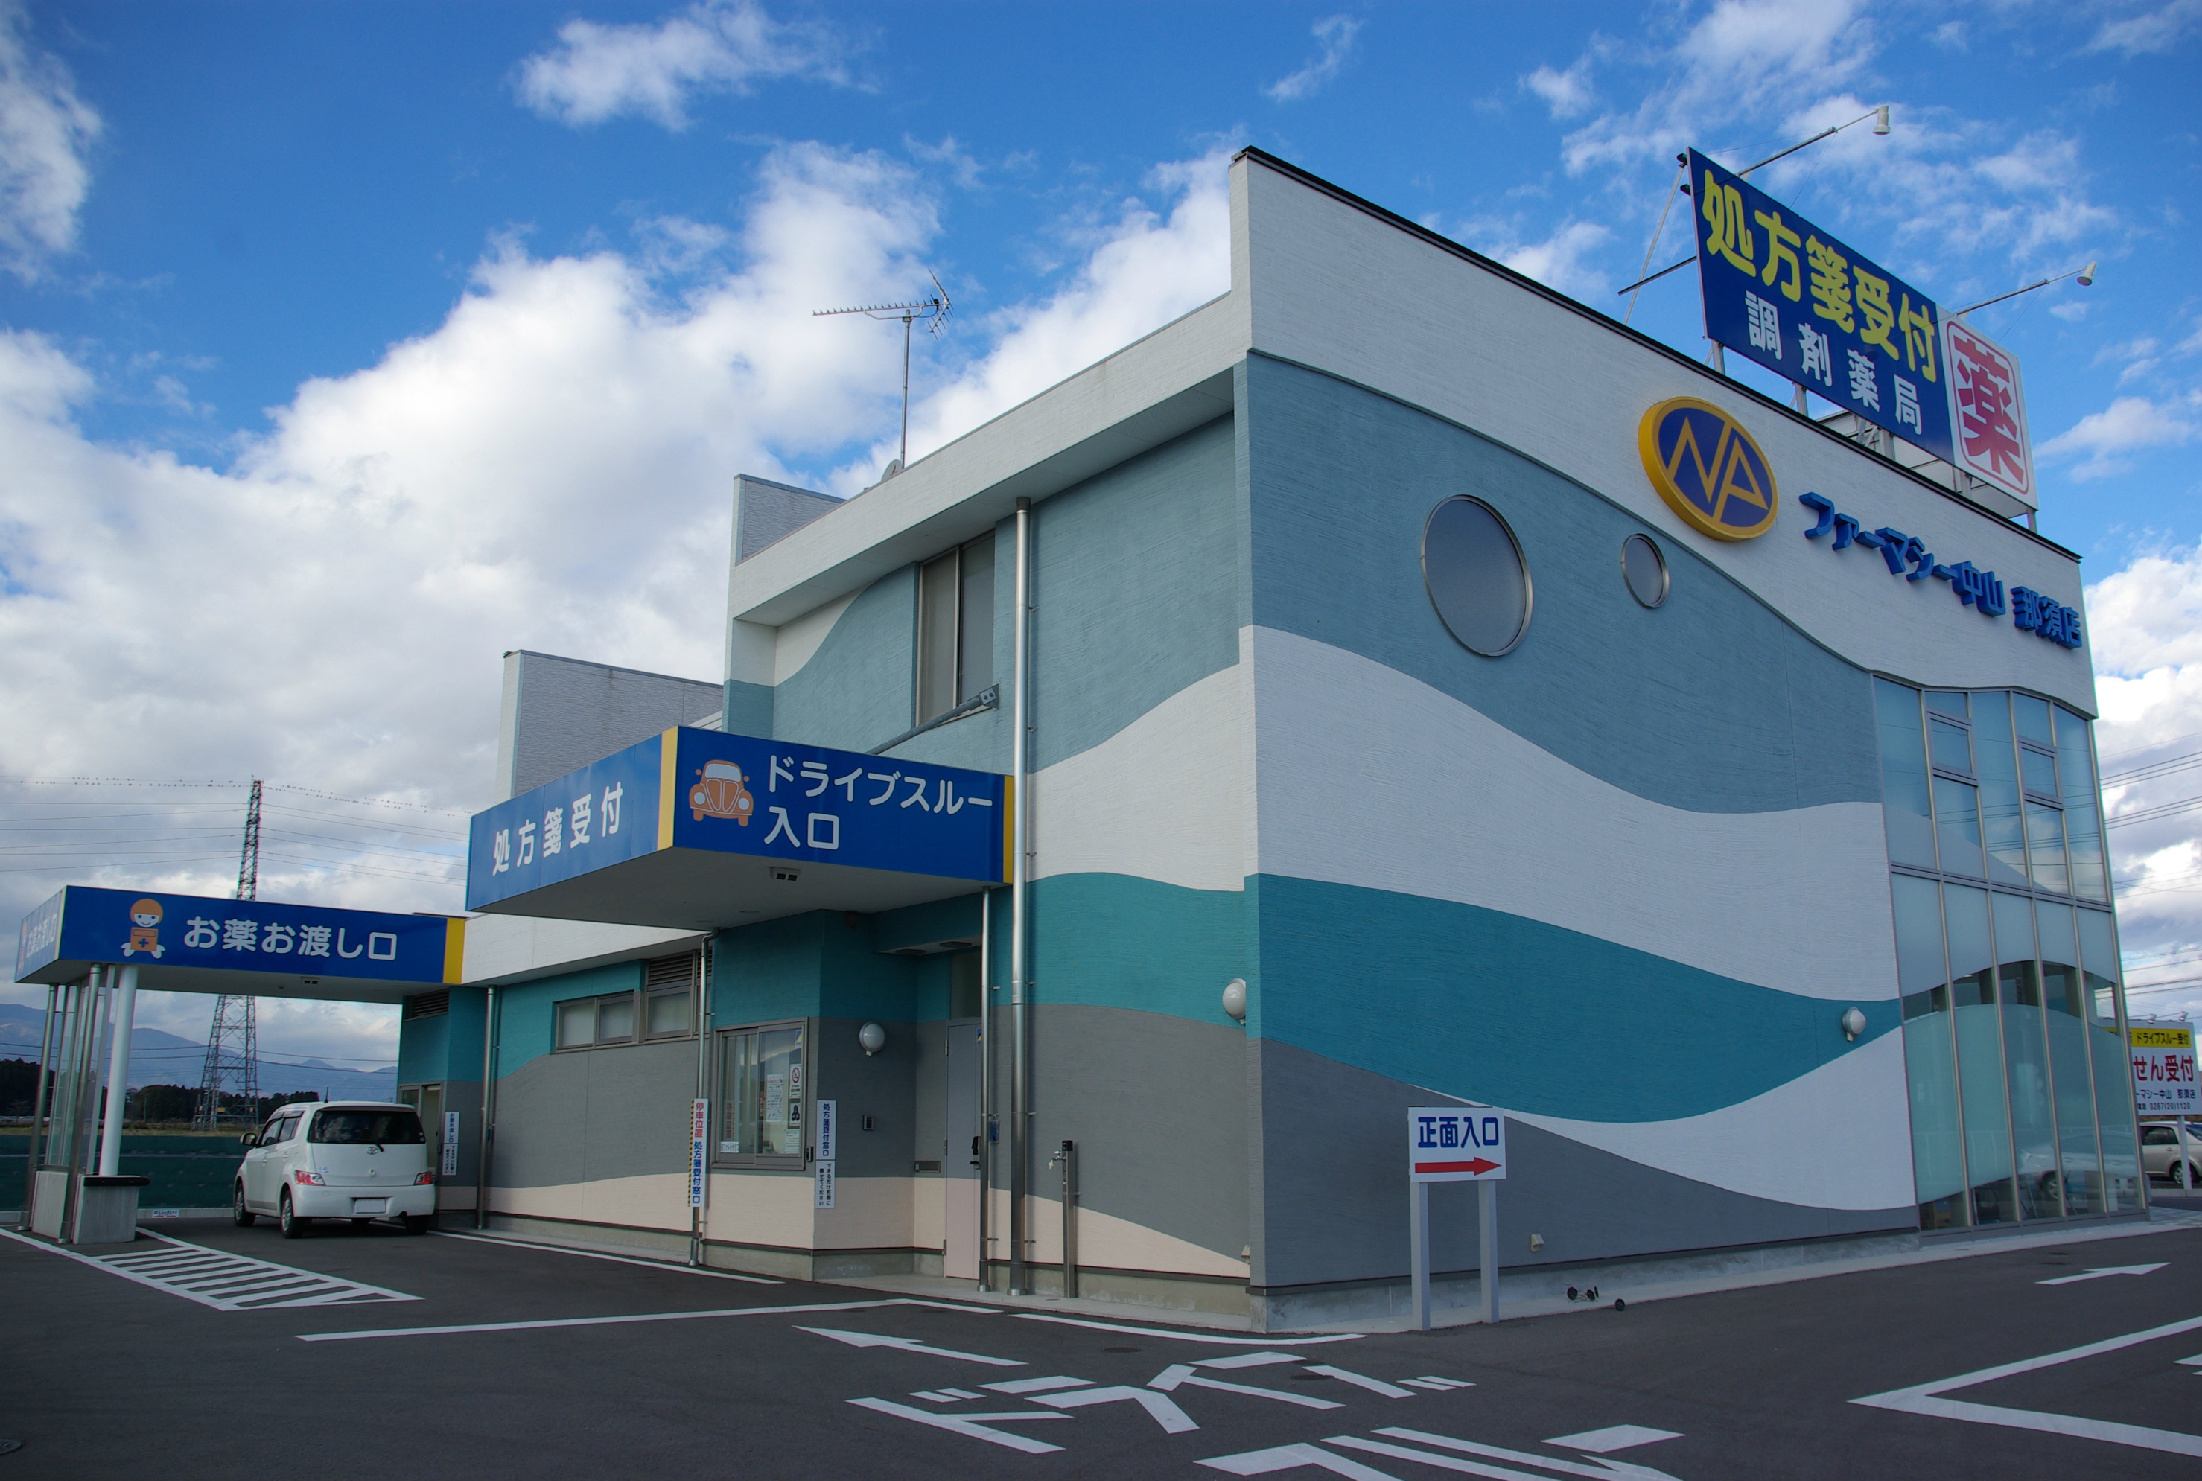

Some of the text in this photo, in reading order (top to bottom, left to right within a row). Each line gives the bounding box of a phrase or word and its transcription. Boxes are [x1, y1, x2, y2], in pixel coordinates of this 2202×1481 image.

[1702, 169, 1937, 383] 処方箋受付
[1745, 290, 1922, 435] 調剤薬局
[1953, 334, 2025, 486] 薬
[1799, 491, 2082, 649] ファーマシー中山 那須店
[768, 754, 994, 816] ドライブスルー
[491, 781, 624, 877] 処方箋受付
[763, 806, 840, 851] 入口
[183, 915, 398, 961] お薬お渡し口
[2133, 1054, 2194, 1082] せん受付
[1417, 1116, 1499, 1148] 正面入口
